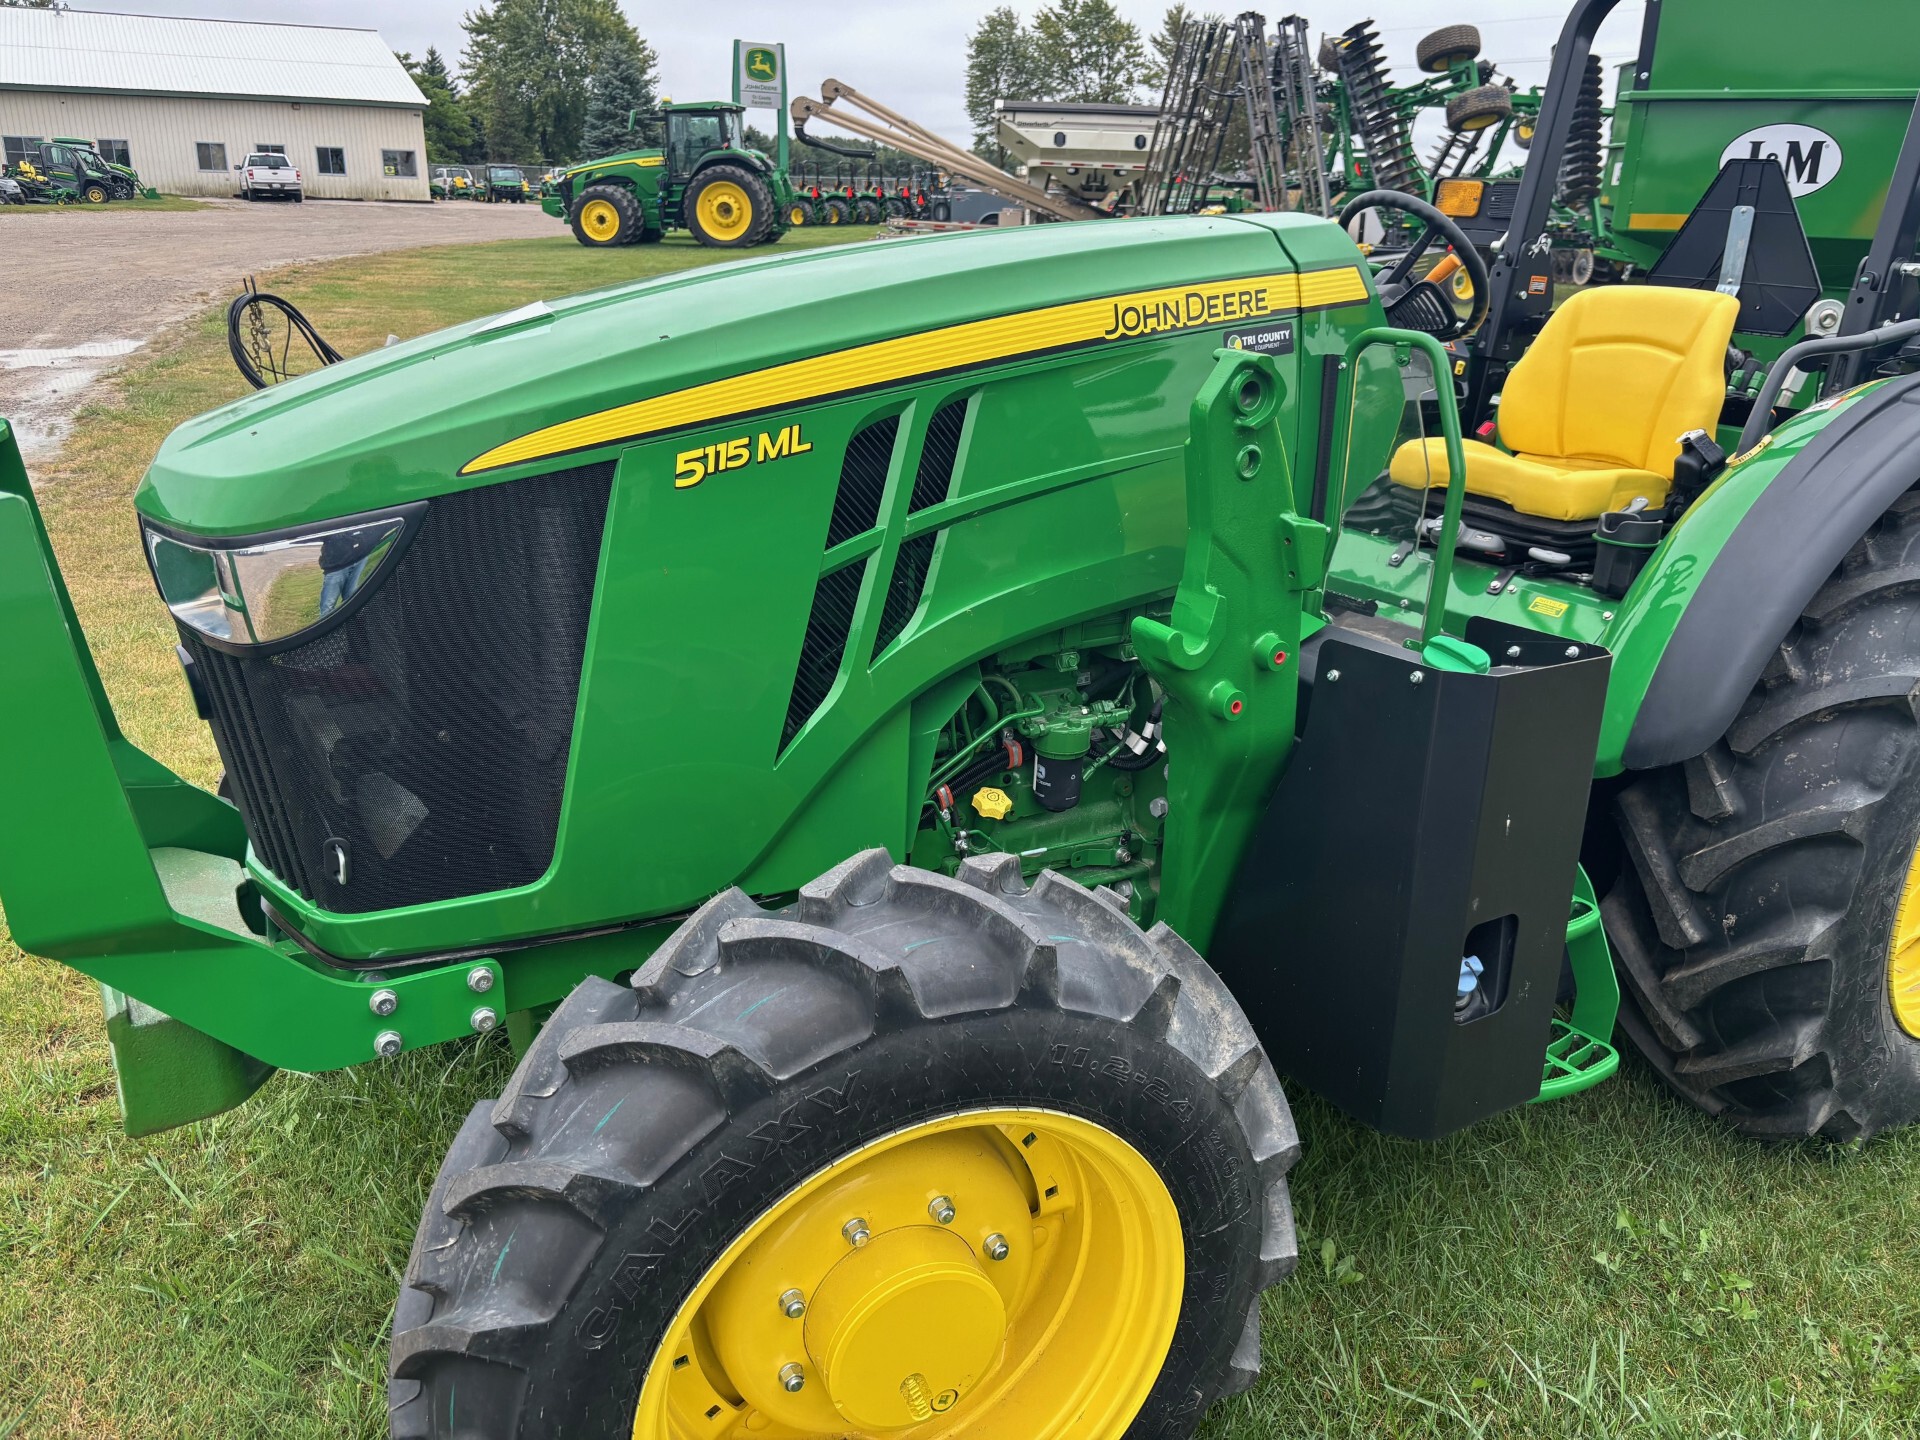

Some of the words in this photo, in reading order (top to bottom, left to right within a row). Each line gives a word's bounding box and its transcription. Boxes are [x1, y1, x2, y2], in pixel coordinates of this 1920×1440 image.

[1105, 299, 1181, 336] JOHN
[1185, 289, 1269, 322] DEERE
[1242, 335, 1256, 346] TRI
[1257, 329, 1290, 344] COUNTY
[1254, 342, 1280, 351] EQUIPMENT
[675, 436, 751, 489] 5115
[757, 424, 813, 464] ML
[577, 1070, 861, 1349] GALAXY
